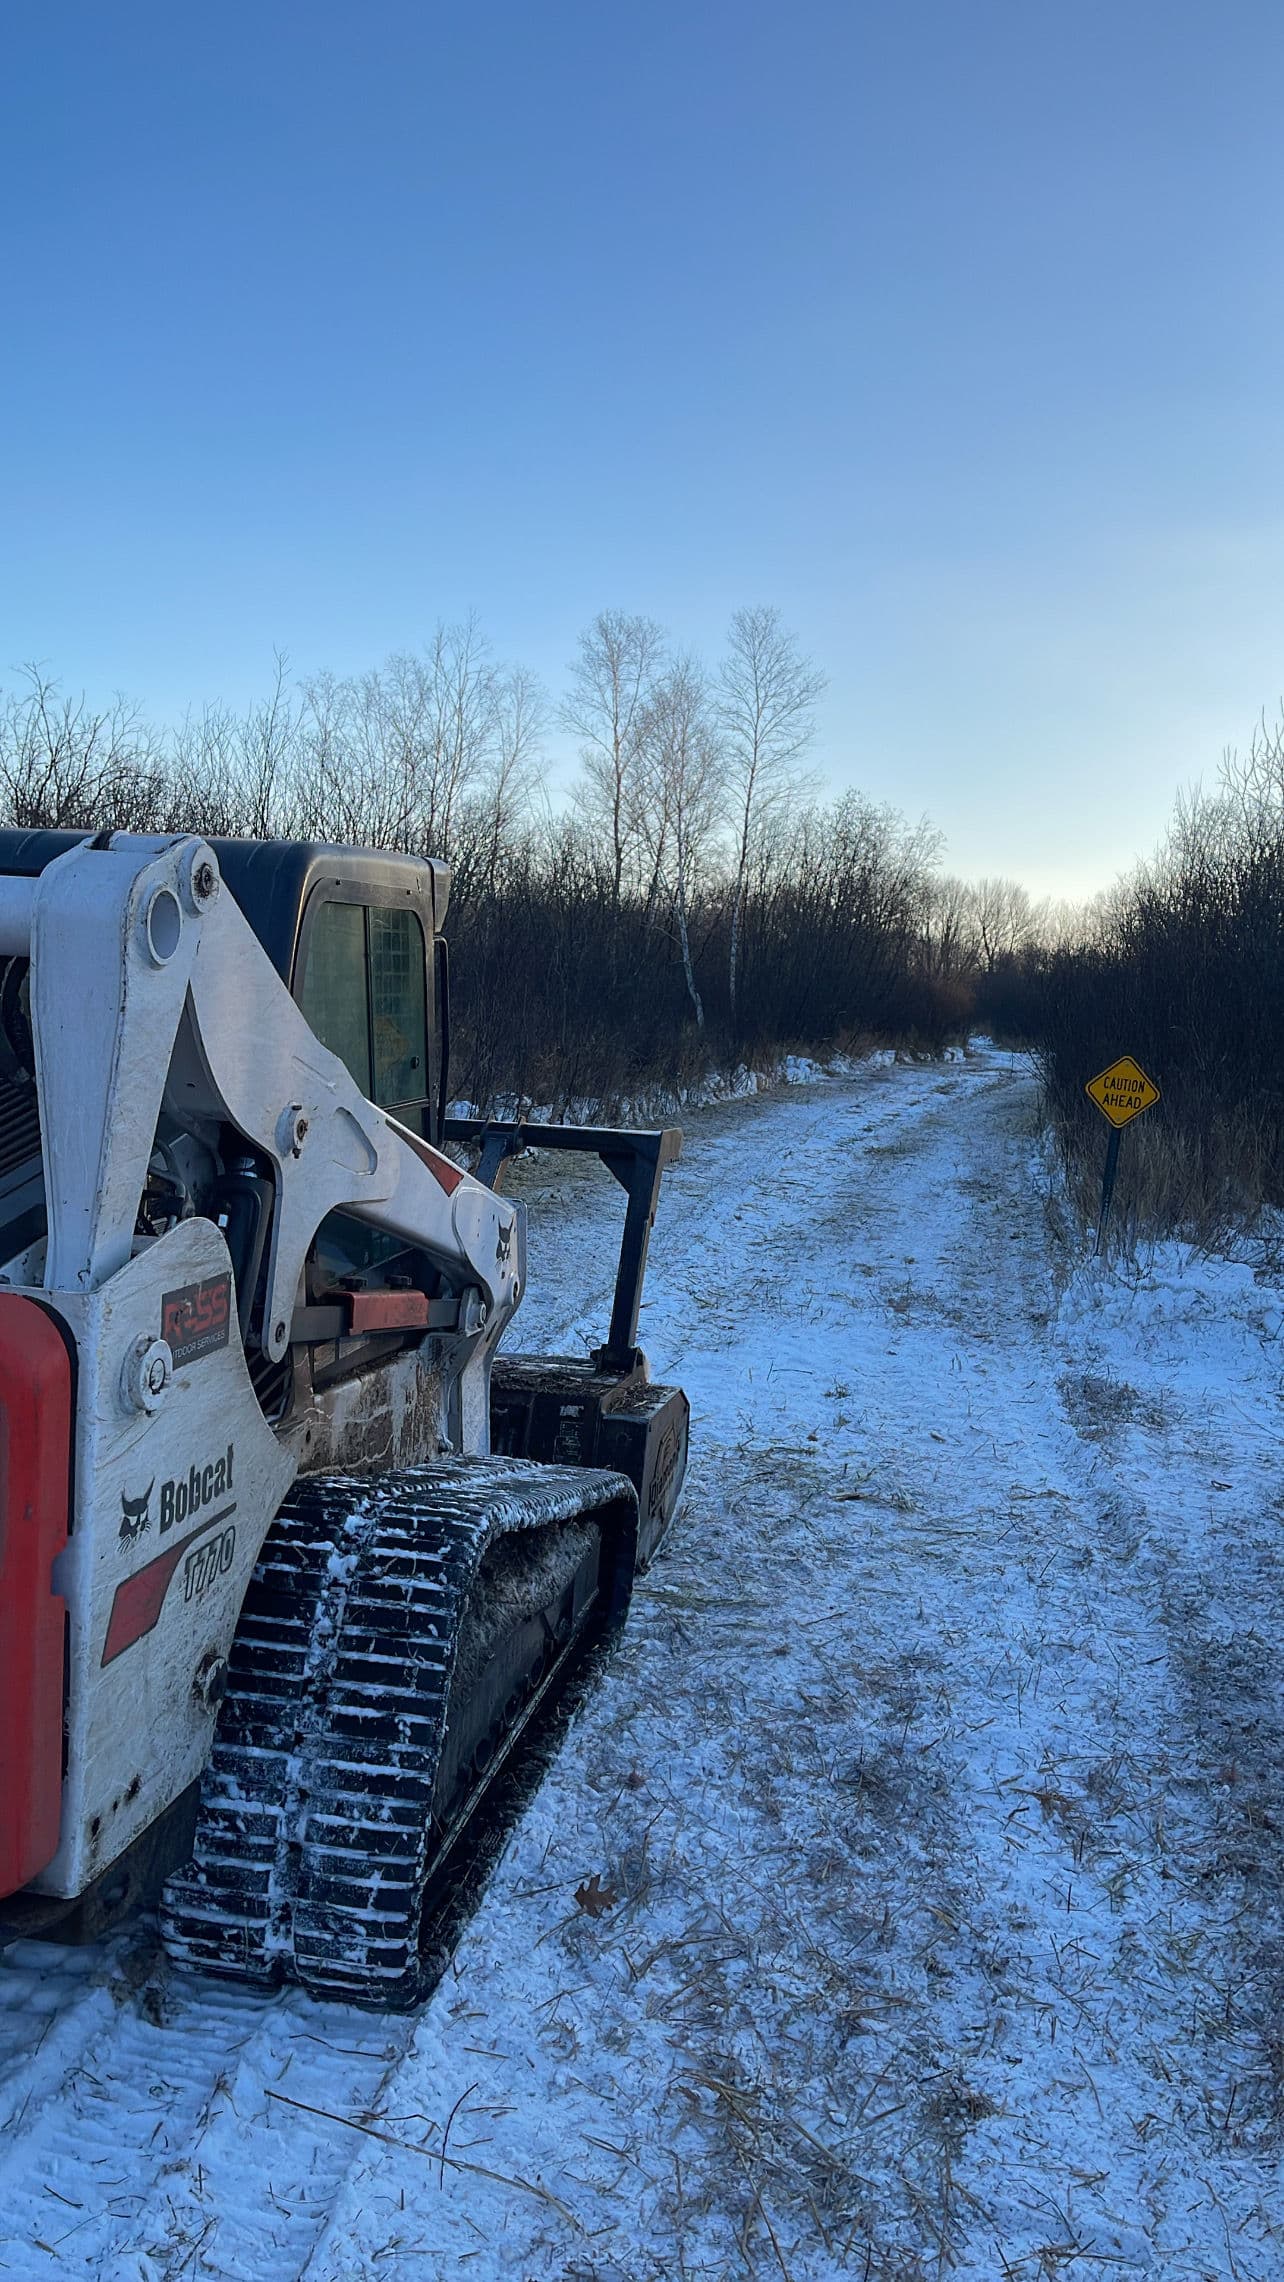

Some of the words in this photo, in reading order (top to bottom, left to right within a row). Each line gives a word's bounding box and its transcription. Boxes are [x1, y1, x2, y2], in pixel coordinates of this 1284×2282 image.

[1103, 1076, 1146, 1093] CAUTION
[1102, 1093, 1142, 1110] AHEAD
[197, 1329, 225, 1350] SERVICES
[160, 1443, 234, 1534] Bobcat
[184, 1525, 236, 1603] T770
